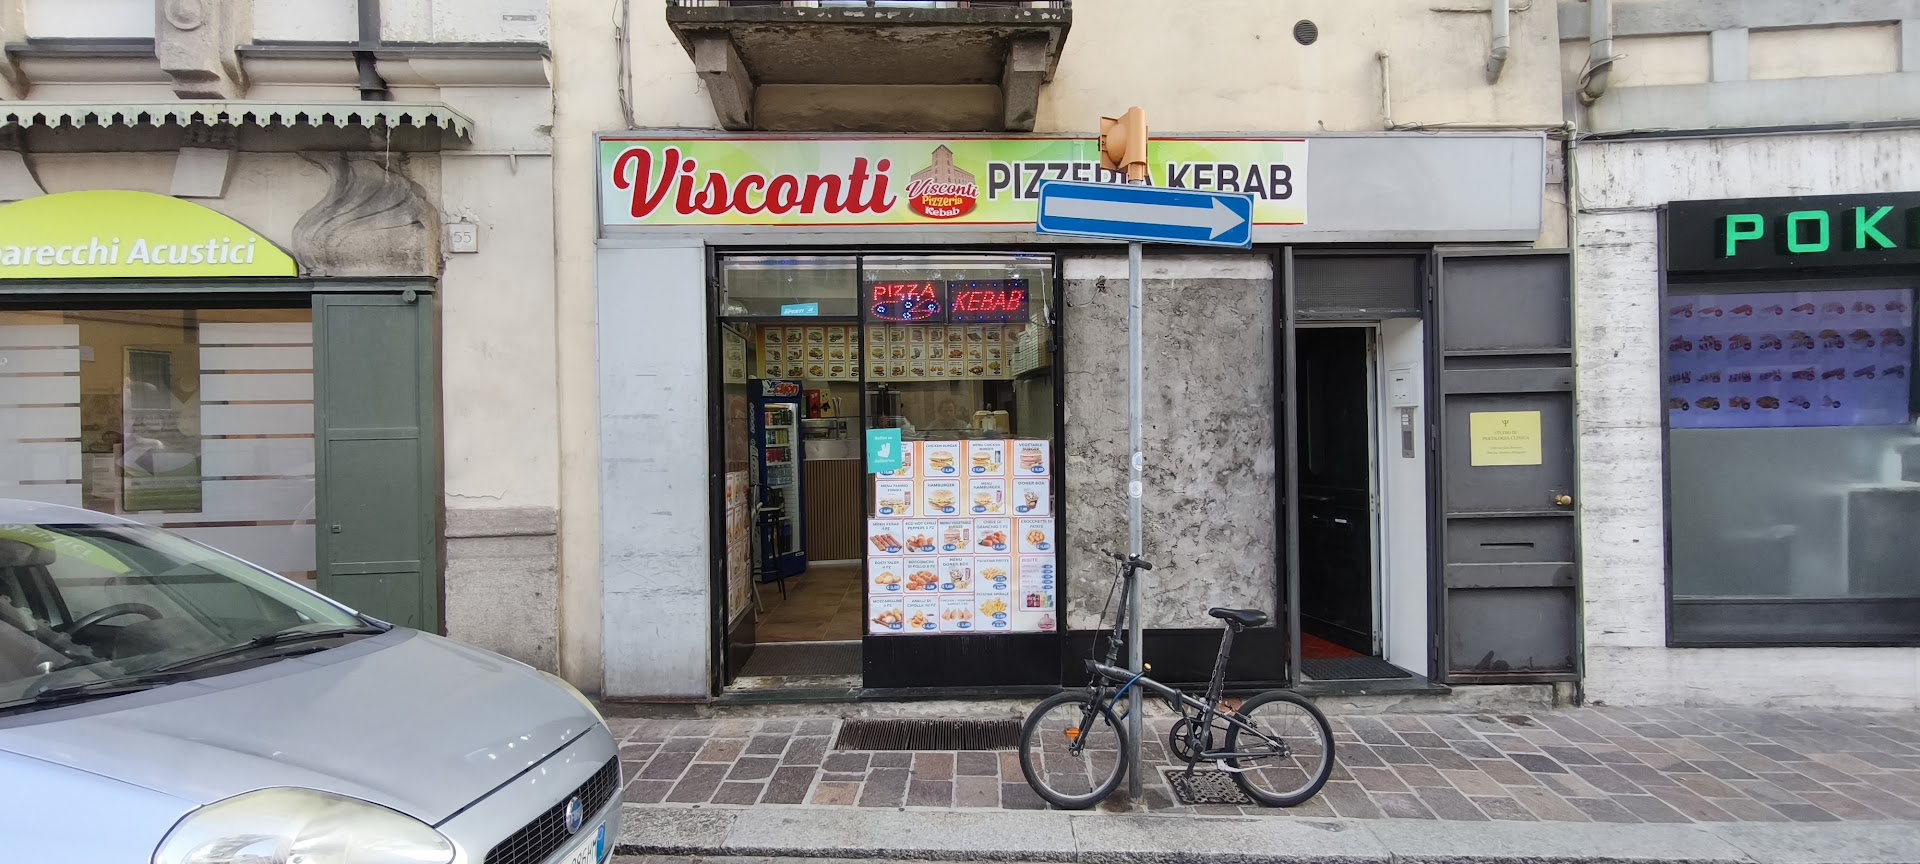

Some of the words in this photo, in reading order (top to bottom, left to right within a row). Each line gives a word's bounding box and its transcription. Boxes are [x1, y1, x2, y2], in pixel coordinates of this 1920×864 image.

[612, 147, 897, 218] Visconti
[905, 178, 980, 199] Visconti
[1168, 163, 1294, 200] KEBAB
[921, 195, 964, 207] Pizzeria
[925, 206, 961, 217] Kebab
[453, 231, 473, 244] 55
[125, 236, 257, 265] Acustici
[873, 283, 936, 301] PIZZA
[953, 290, 1025, 313] KEBAB
